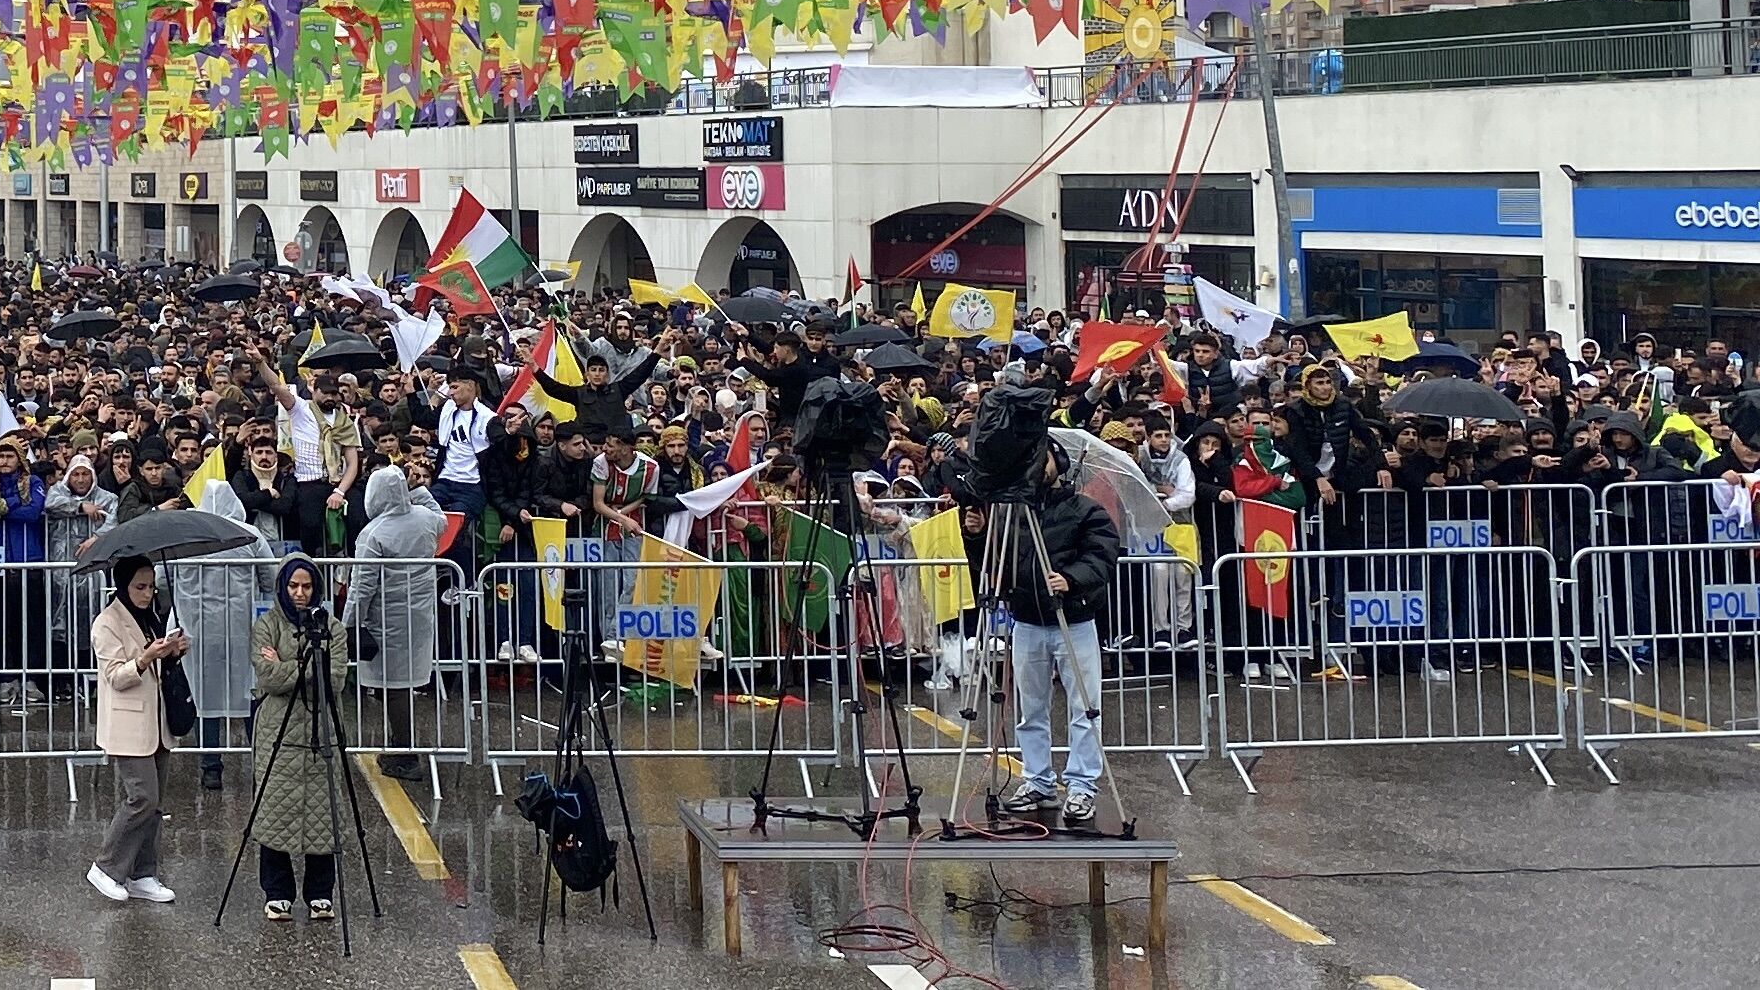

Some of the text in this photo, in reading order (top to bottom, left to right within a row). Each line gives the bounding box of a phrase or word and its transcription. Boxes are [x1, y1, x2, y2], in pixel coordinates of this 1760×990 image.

[722, 170, 760, 203] eve
[1675, 201, 1760, 229] ebebe
[930, 250, 956, 275] eve
[1430, 522, 1490, 547] POLİS
[620, 606, 697, 638] POLİS
[1350, 593, 1424, 626] POLİS
